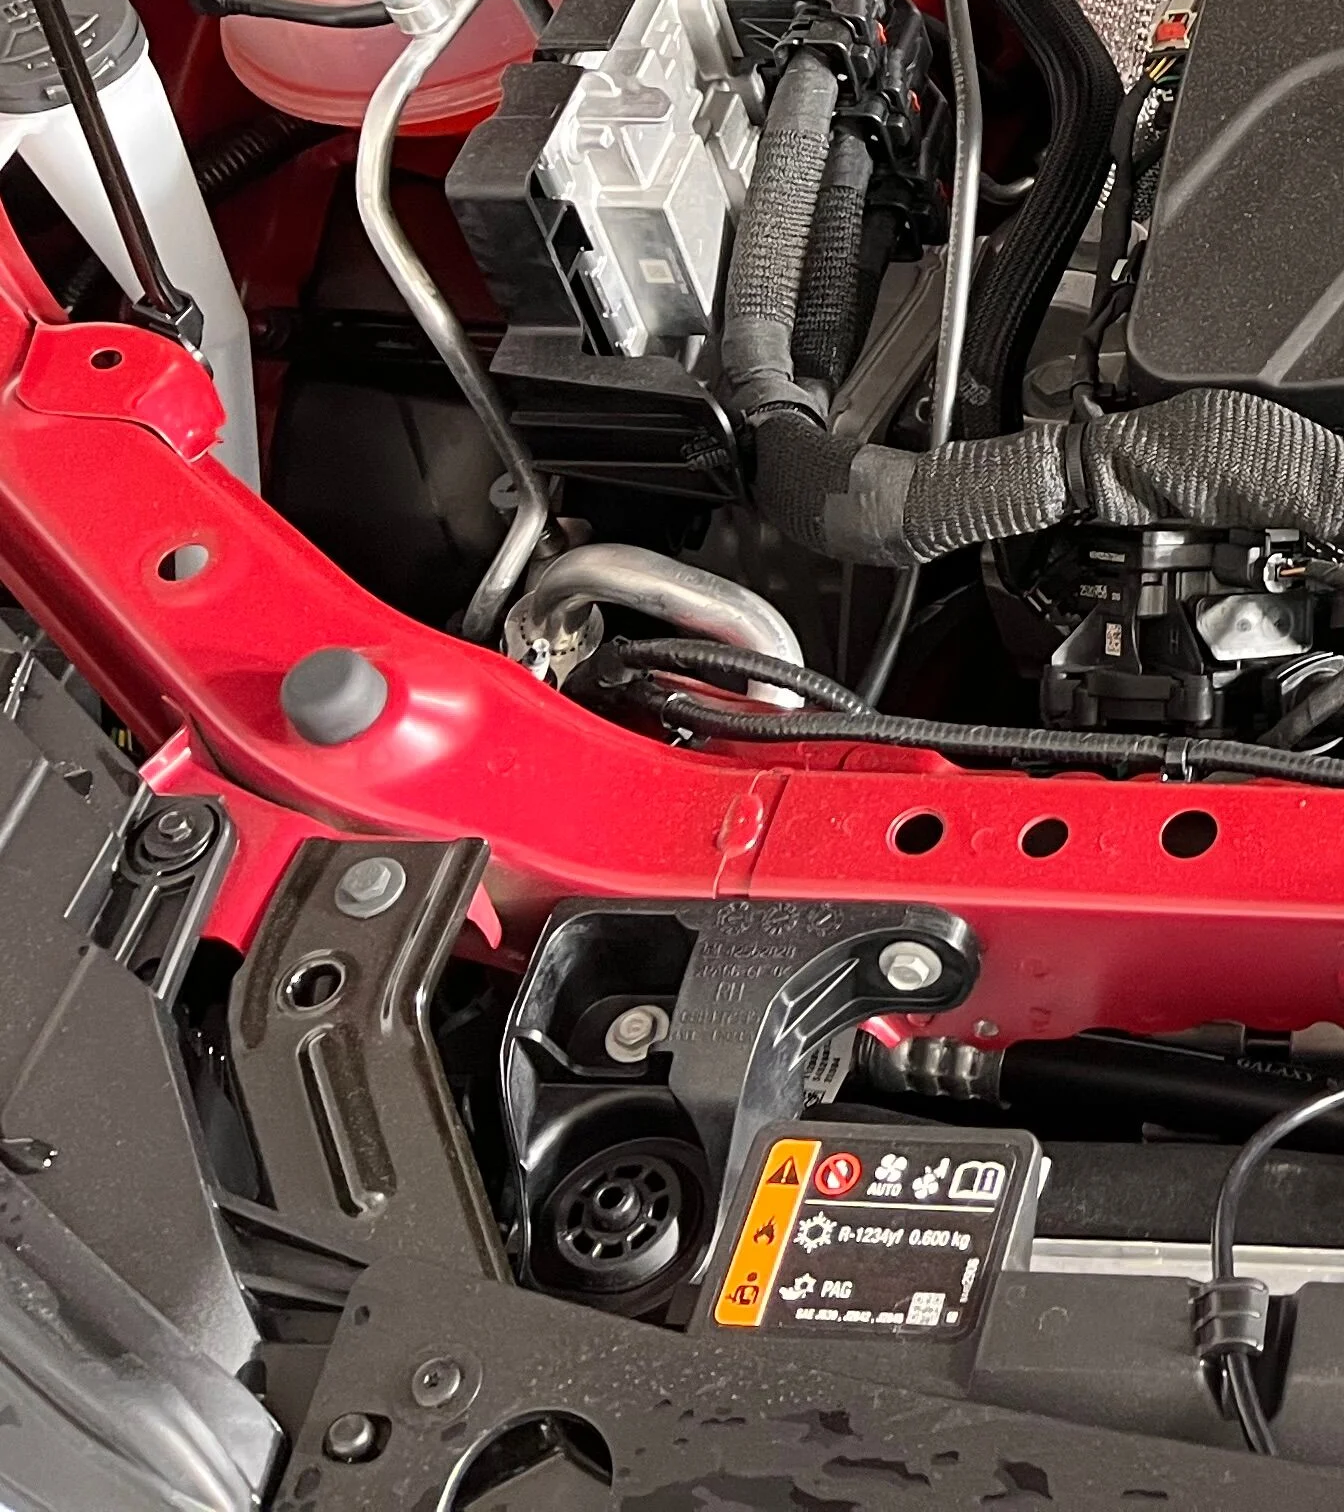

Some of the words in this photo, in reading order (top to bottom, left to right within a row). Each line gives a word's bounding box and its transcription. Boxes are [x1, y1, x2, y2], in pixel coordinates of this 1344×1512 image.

[1237, 1057, 1313, 1083] GALAXY
[867, 1182, 902, 1197] AUTO
[820, 1280, 853, 1299] PAG
